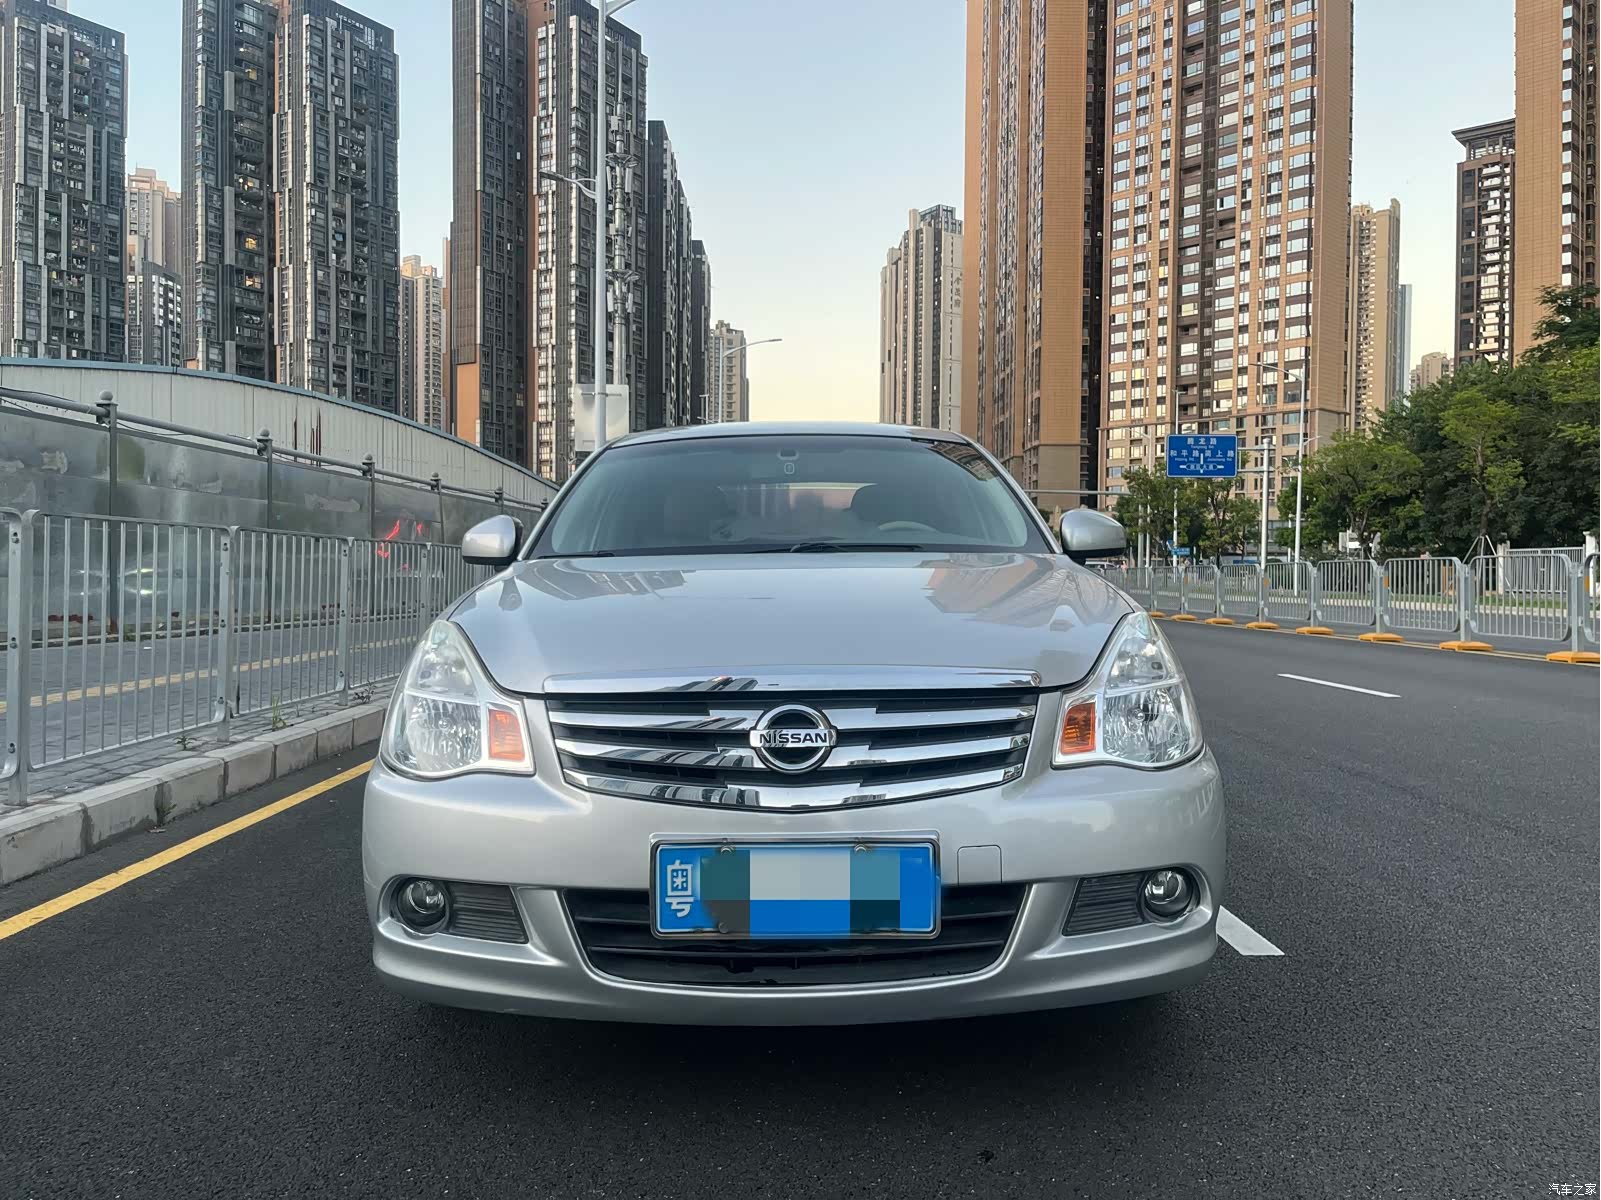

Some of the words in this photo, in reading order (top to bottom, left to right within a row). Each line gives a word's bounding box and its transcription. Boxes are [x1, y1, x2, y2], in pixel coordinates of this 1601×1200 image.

[1170, 449, 1199, 457] 和平路
[759, 732, 827, 744] NISSAN
[665, 859, 695, 918] 粤
